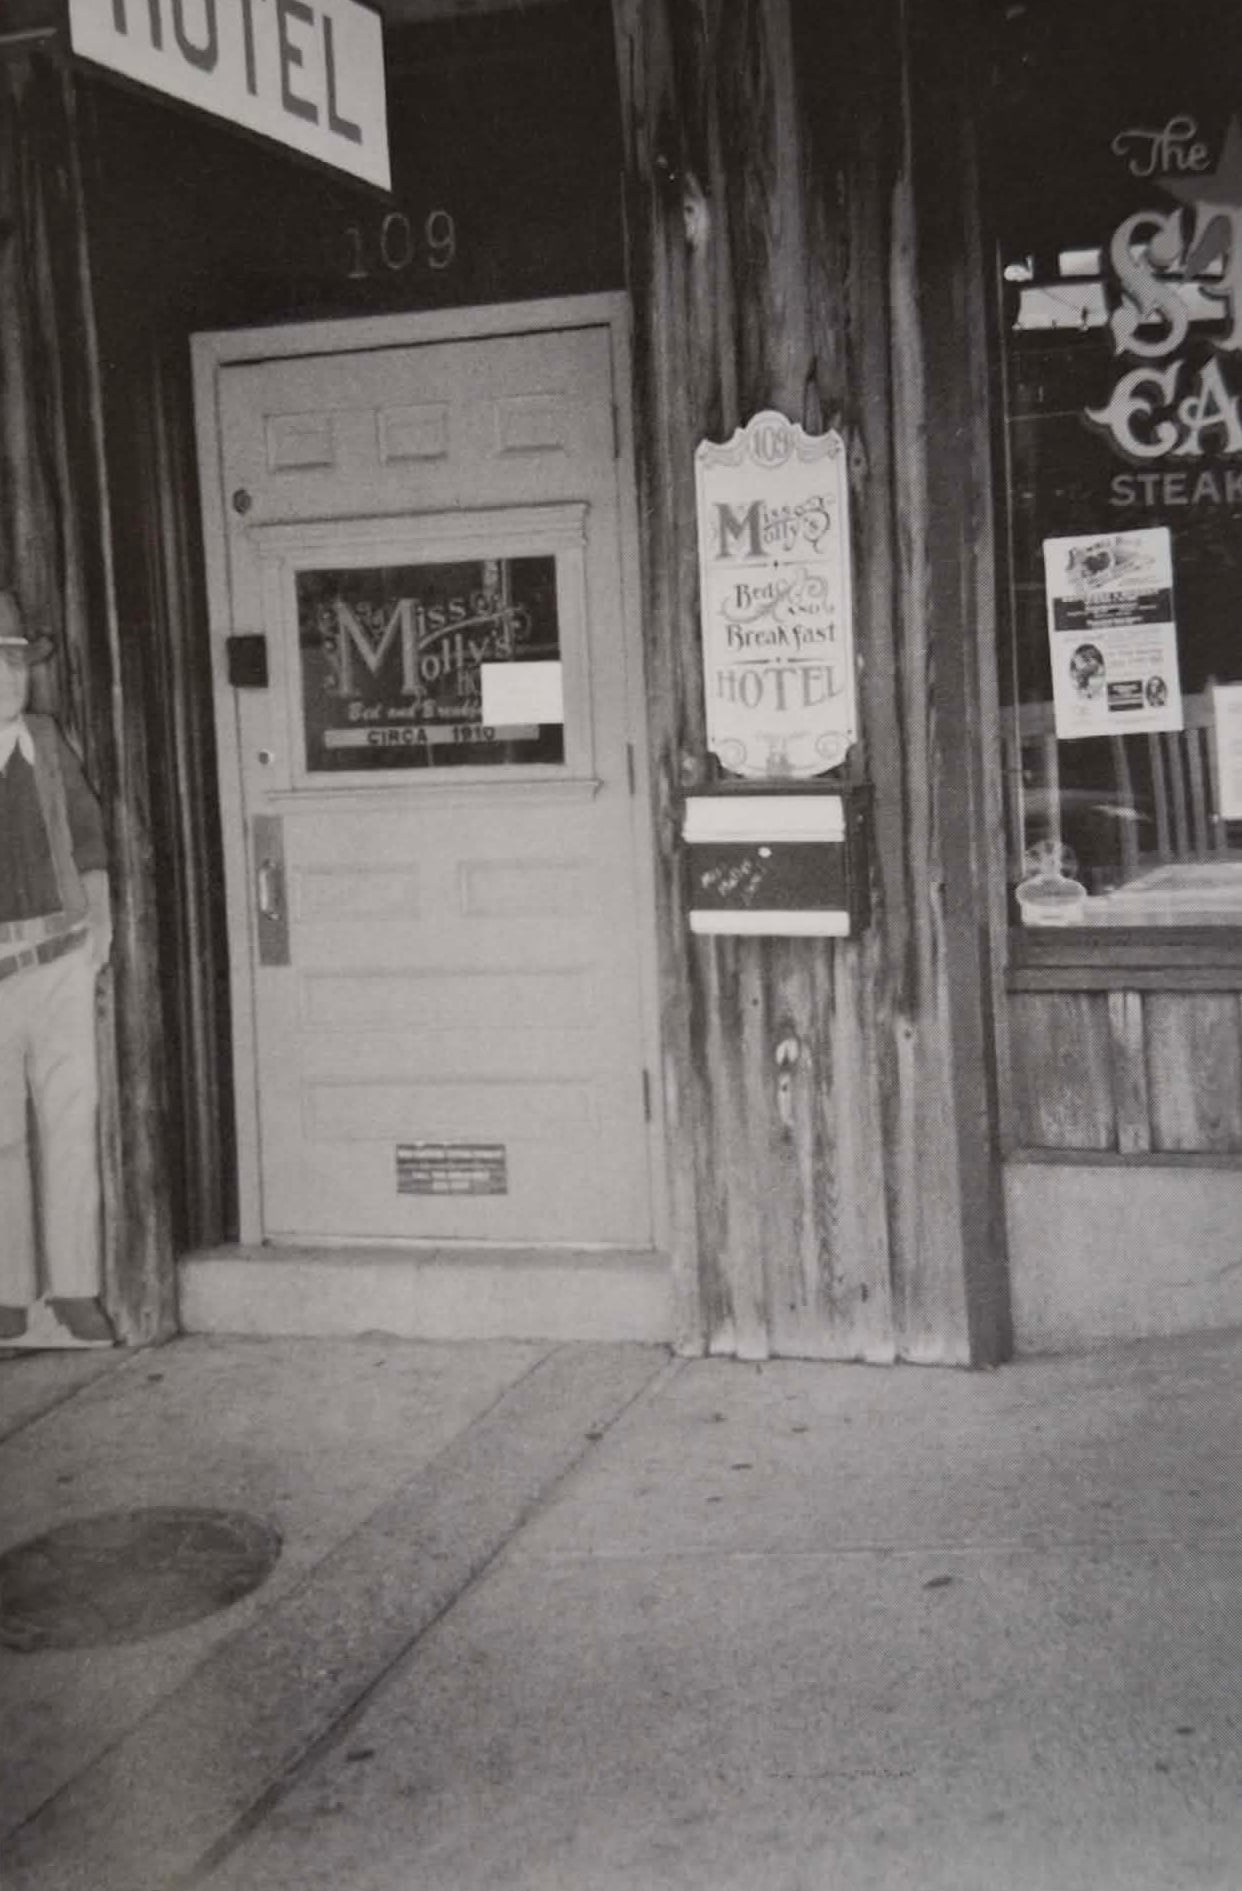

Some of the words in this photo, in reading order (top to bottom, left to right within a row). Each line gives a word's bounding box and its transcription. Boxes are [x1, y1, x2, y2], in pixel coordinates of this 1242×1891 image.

[1111, 115, 1211, 177] The
[343, 210, 456, 279] 109
[735, 582, 773, 608] Bed
[726, 621, 836, 651] Breakfast
[716, 665, 845, 712] HOTEL
[367, 727, 428, 745] CIRCA
